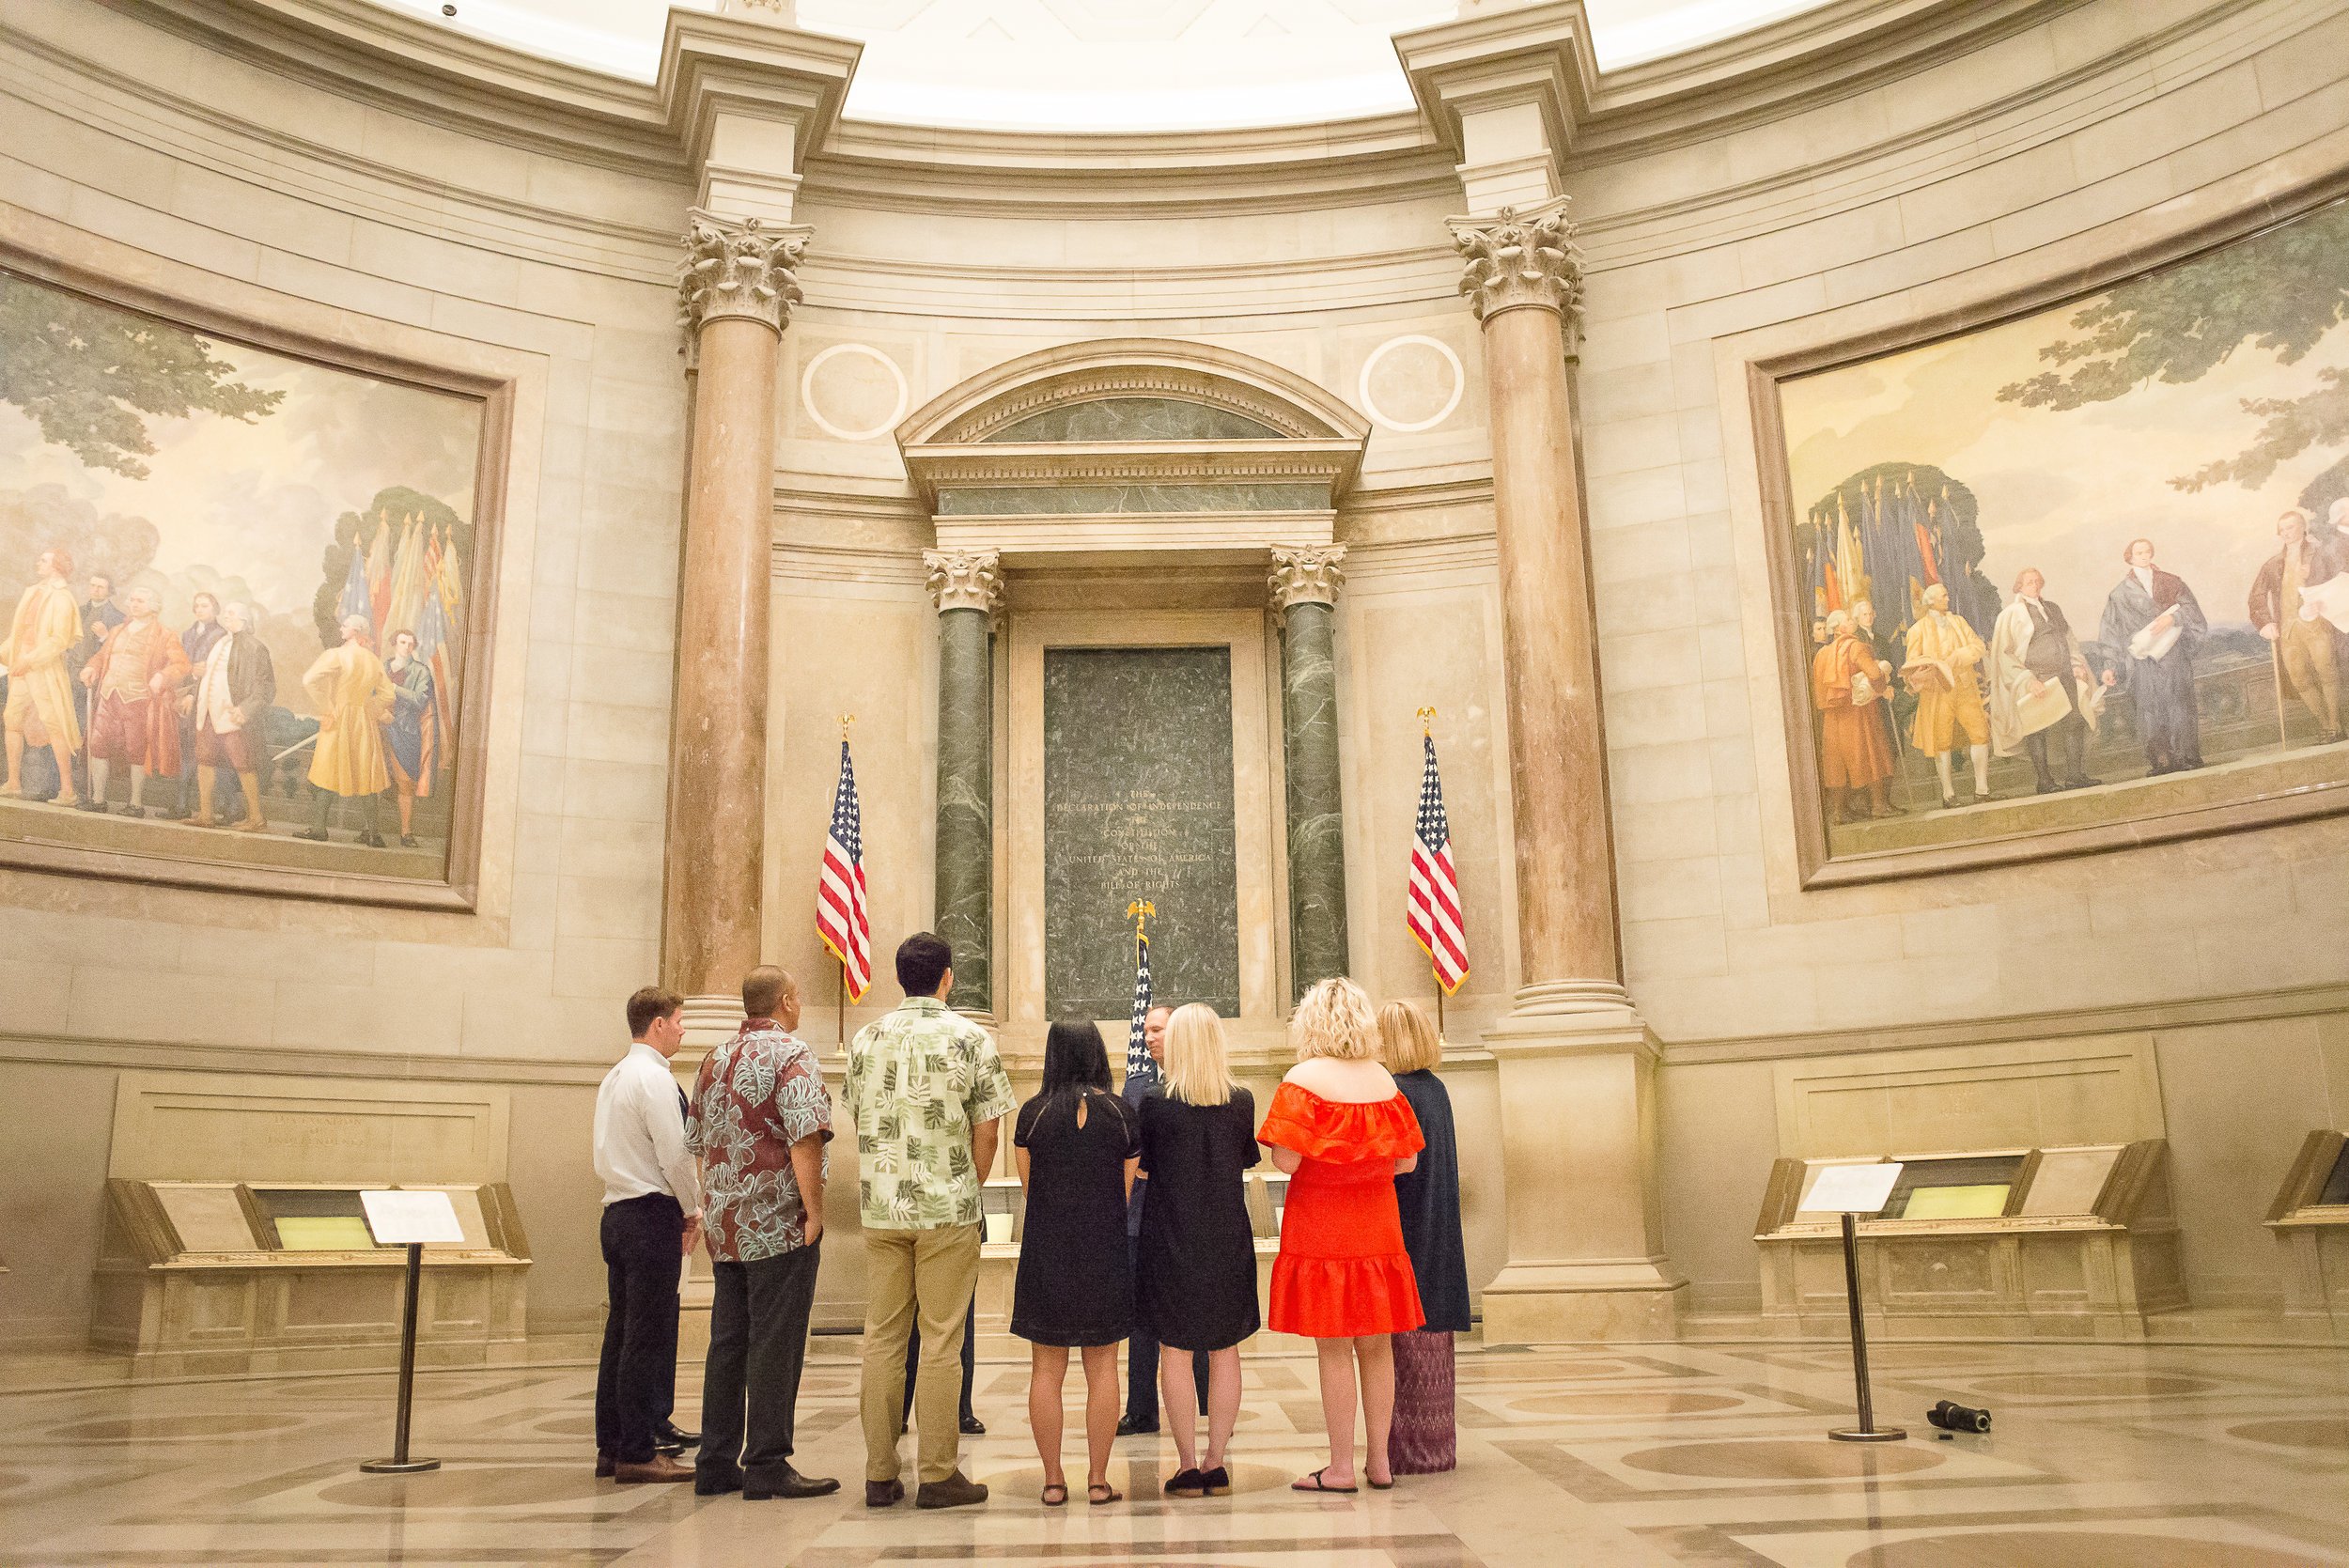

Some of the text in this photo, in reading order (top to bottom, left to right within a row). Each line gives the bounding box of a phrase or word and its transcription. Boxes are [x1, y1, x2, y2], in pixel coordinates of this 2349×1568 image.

[1056, 801, 1221, 812] DECLARATION OF INDEPENDENCE
[1169, 854, 1211, 862] AMERICA
